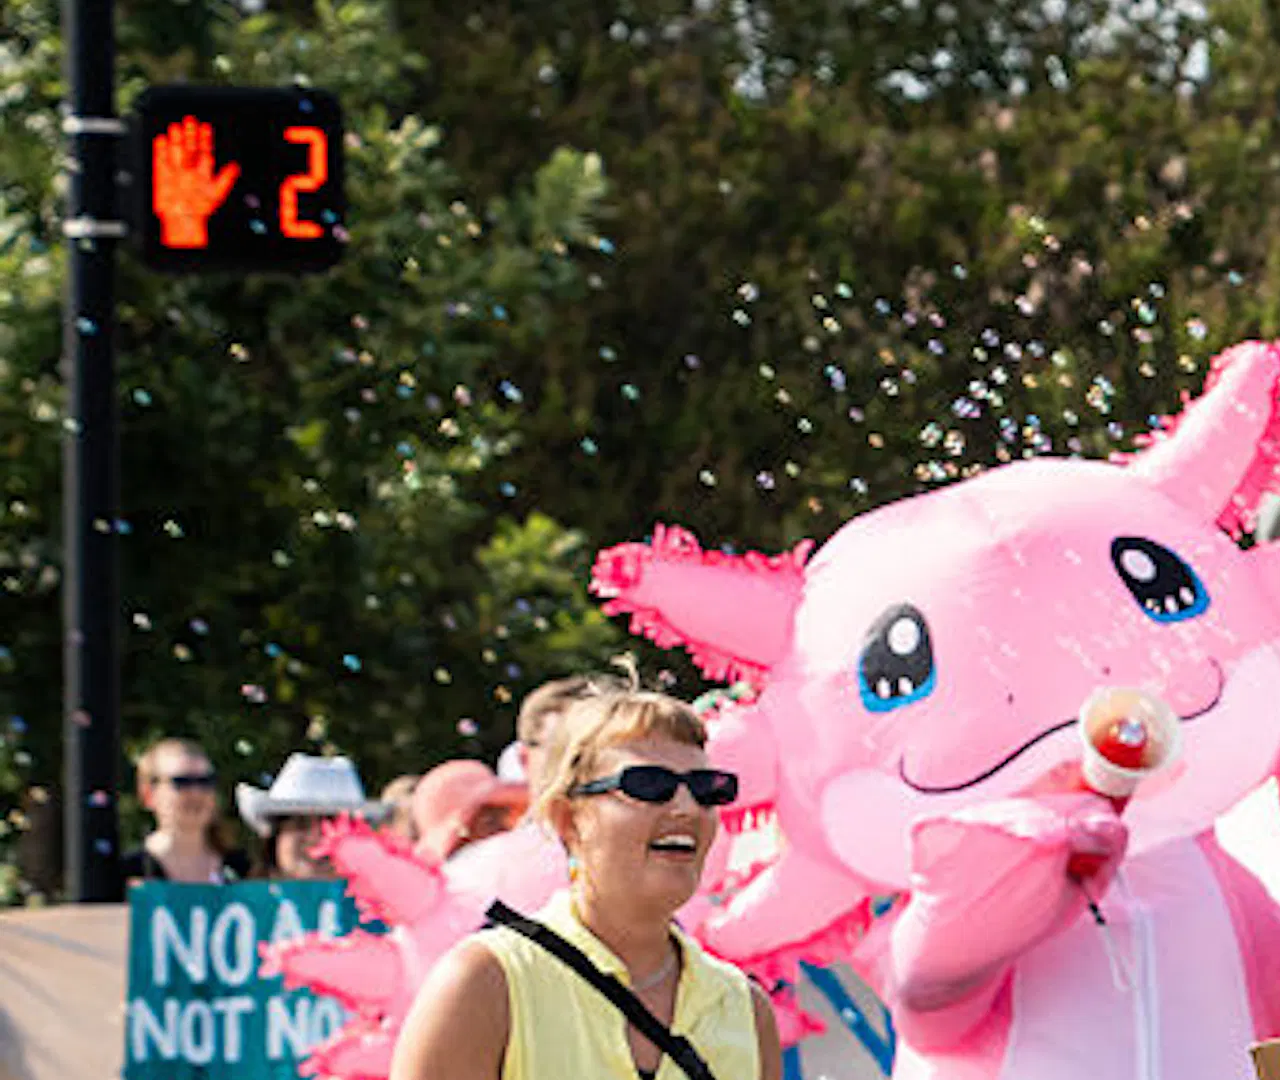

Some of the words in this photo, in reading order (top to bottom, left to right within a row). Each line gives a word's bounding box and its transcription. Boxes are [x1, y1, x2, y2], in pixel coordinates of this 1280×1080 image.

[279, 126, 328, 238] 2
[151, 902, 257, 987] NO
[130, 995, 254, 1064] NOT
[266, 995, 356, 1061] NO
